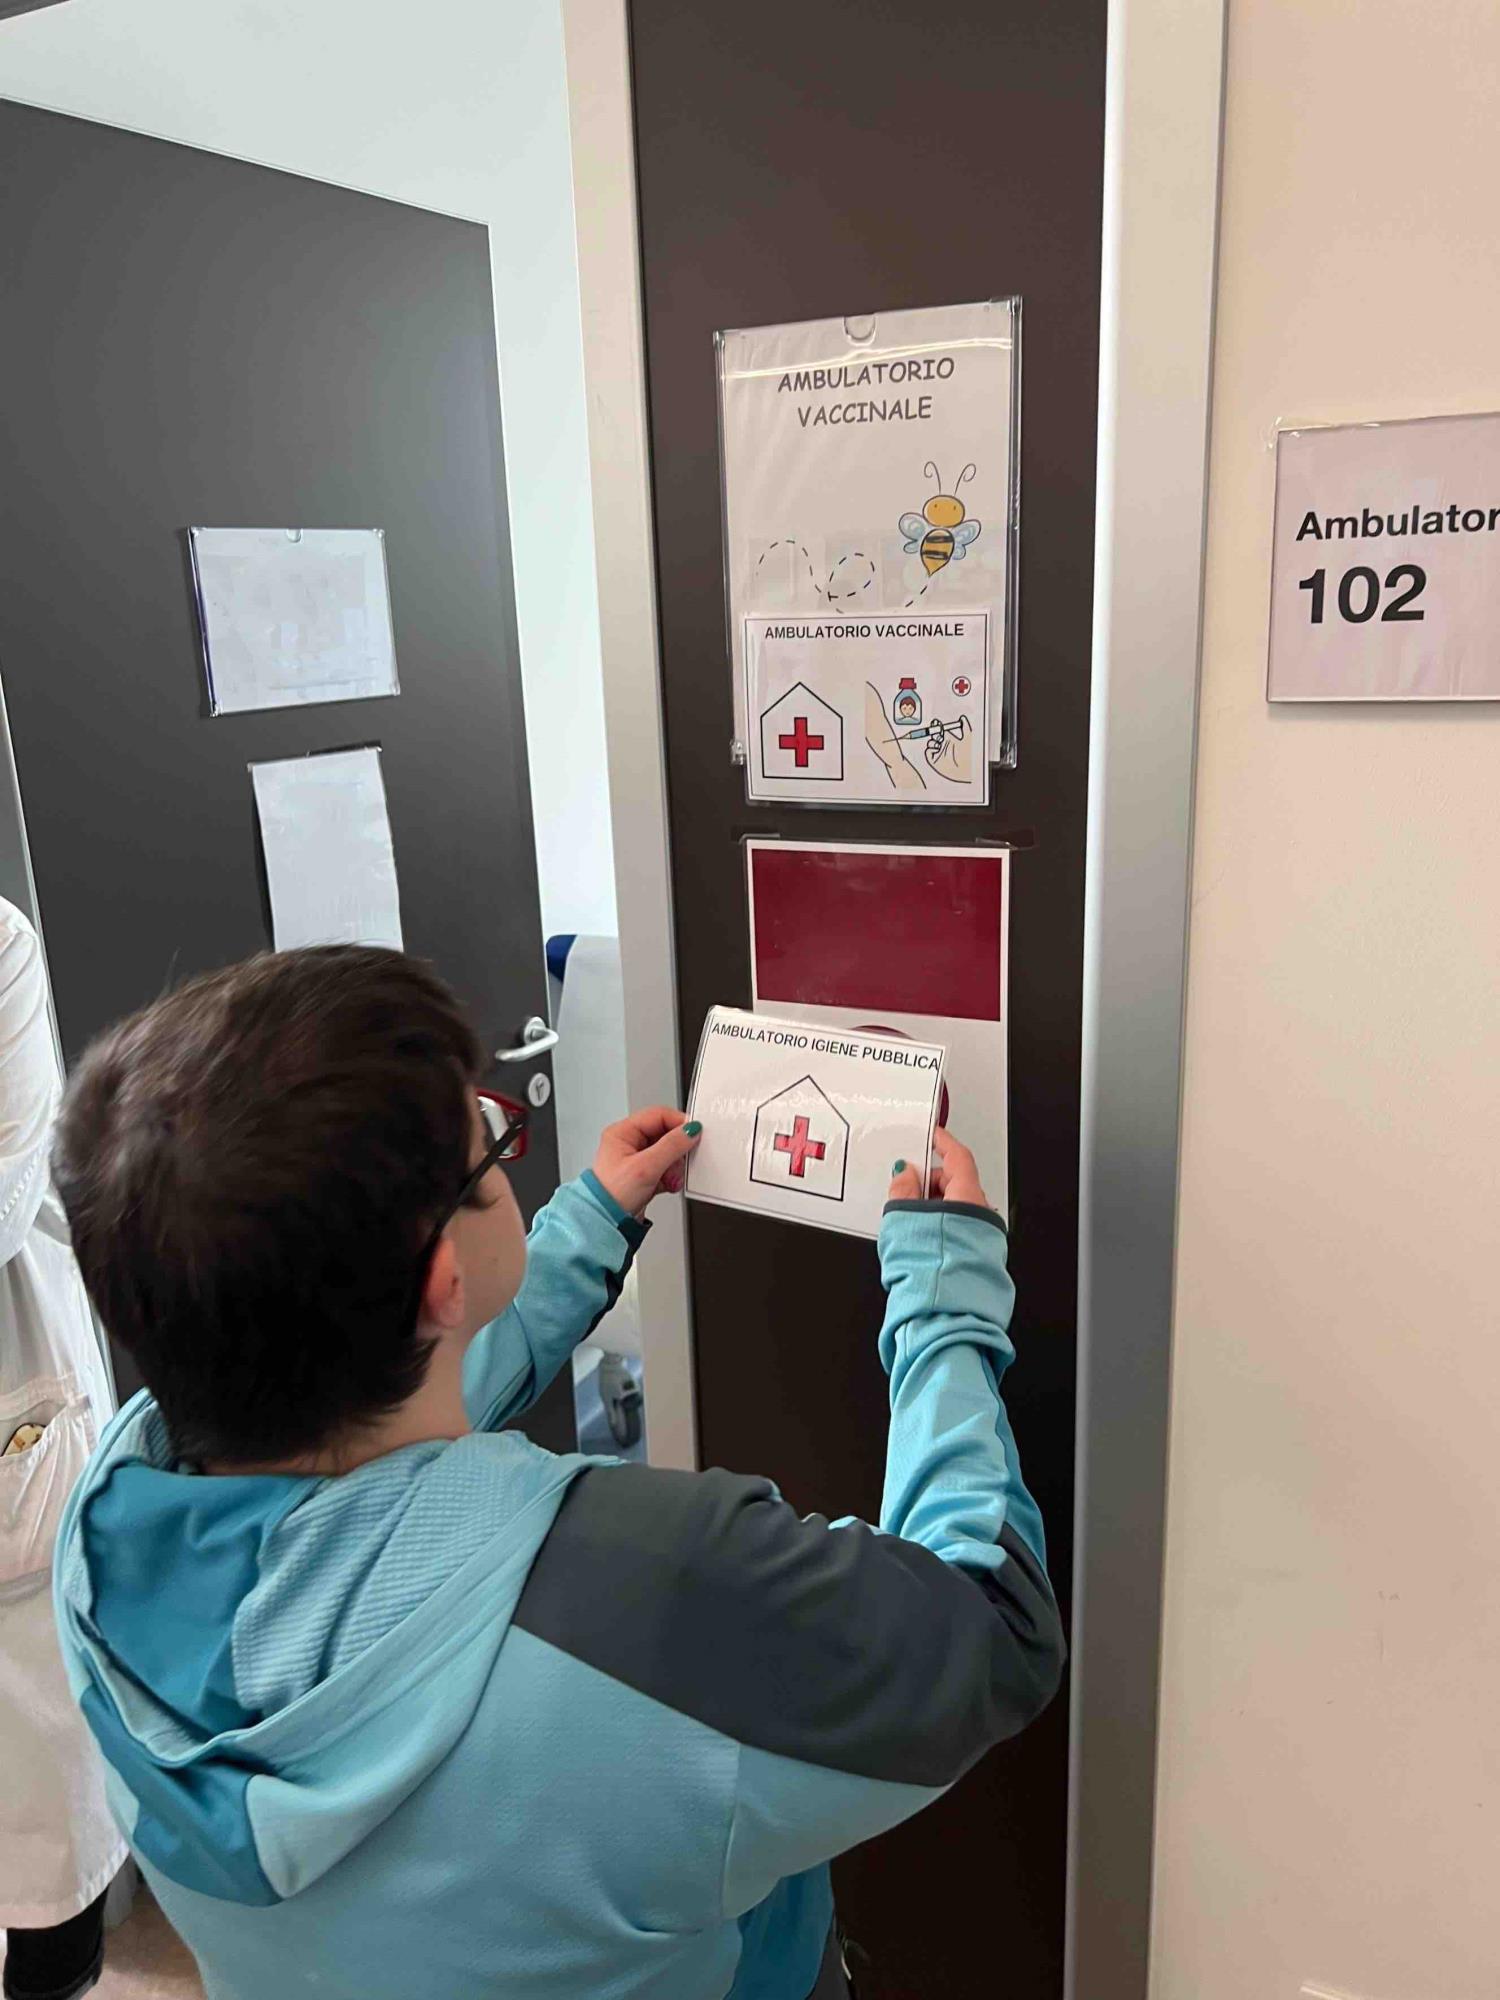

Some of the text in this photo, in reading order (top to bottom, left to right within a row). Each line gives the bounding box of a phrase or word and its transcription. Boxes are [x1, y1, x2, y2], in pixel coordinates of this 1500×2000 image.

[777, 357, 955, 393] AMBULATORIO
[797, 396, 933, 428] VACCINALE
[1298, 564, 1427, 624] 102
[765, 623, 964, 639] AMBULATORIO VACCINALE
[711, 1023, 940, 1071] AMBULATORIO IGIENE PUBBLICA
